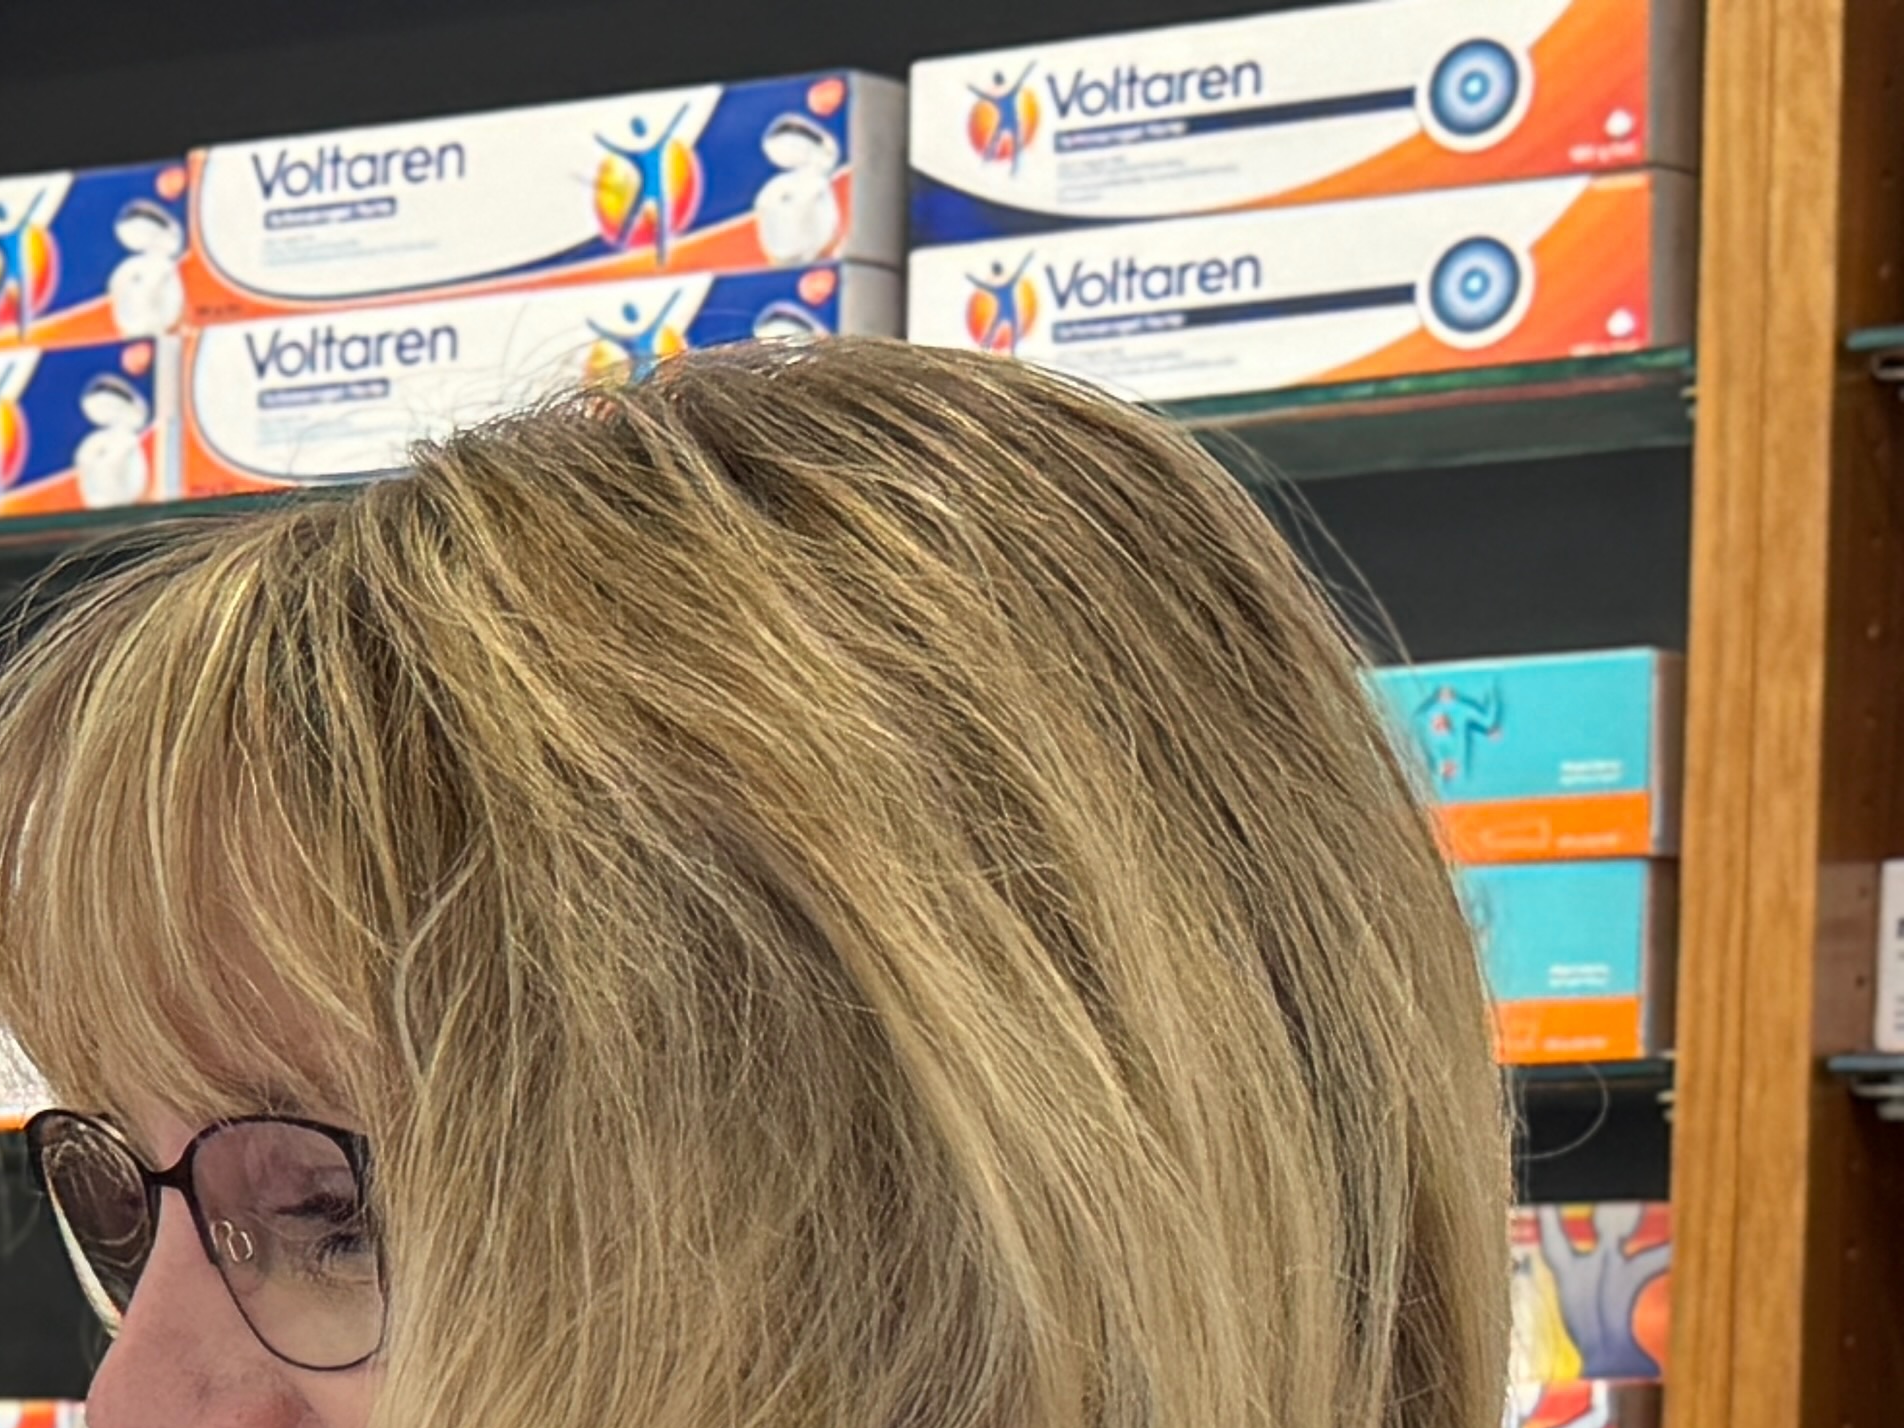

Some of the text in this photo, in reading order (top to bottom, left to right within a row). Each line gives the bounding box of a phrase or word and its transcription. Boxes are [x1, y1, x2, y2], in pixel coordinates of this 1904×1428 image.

[1046, 60, 1262, 119] Voltaren
[251, 142, 466, 201] Voltaren
[1045, 254, 1262, 310] Voltaren
[245, 325, 459, 379] Voltaren
